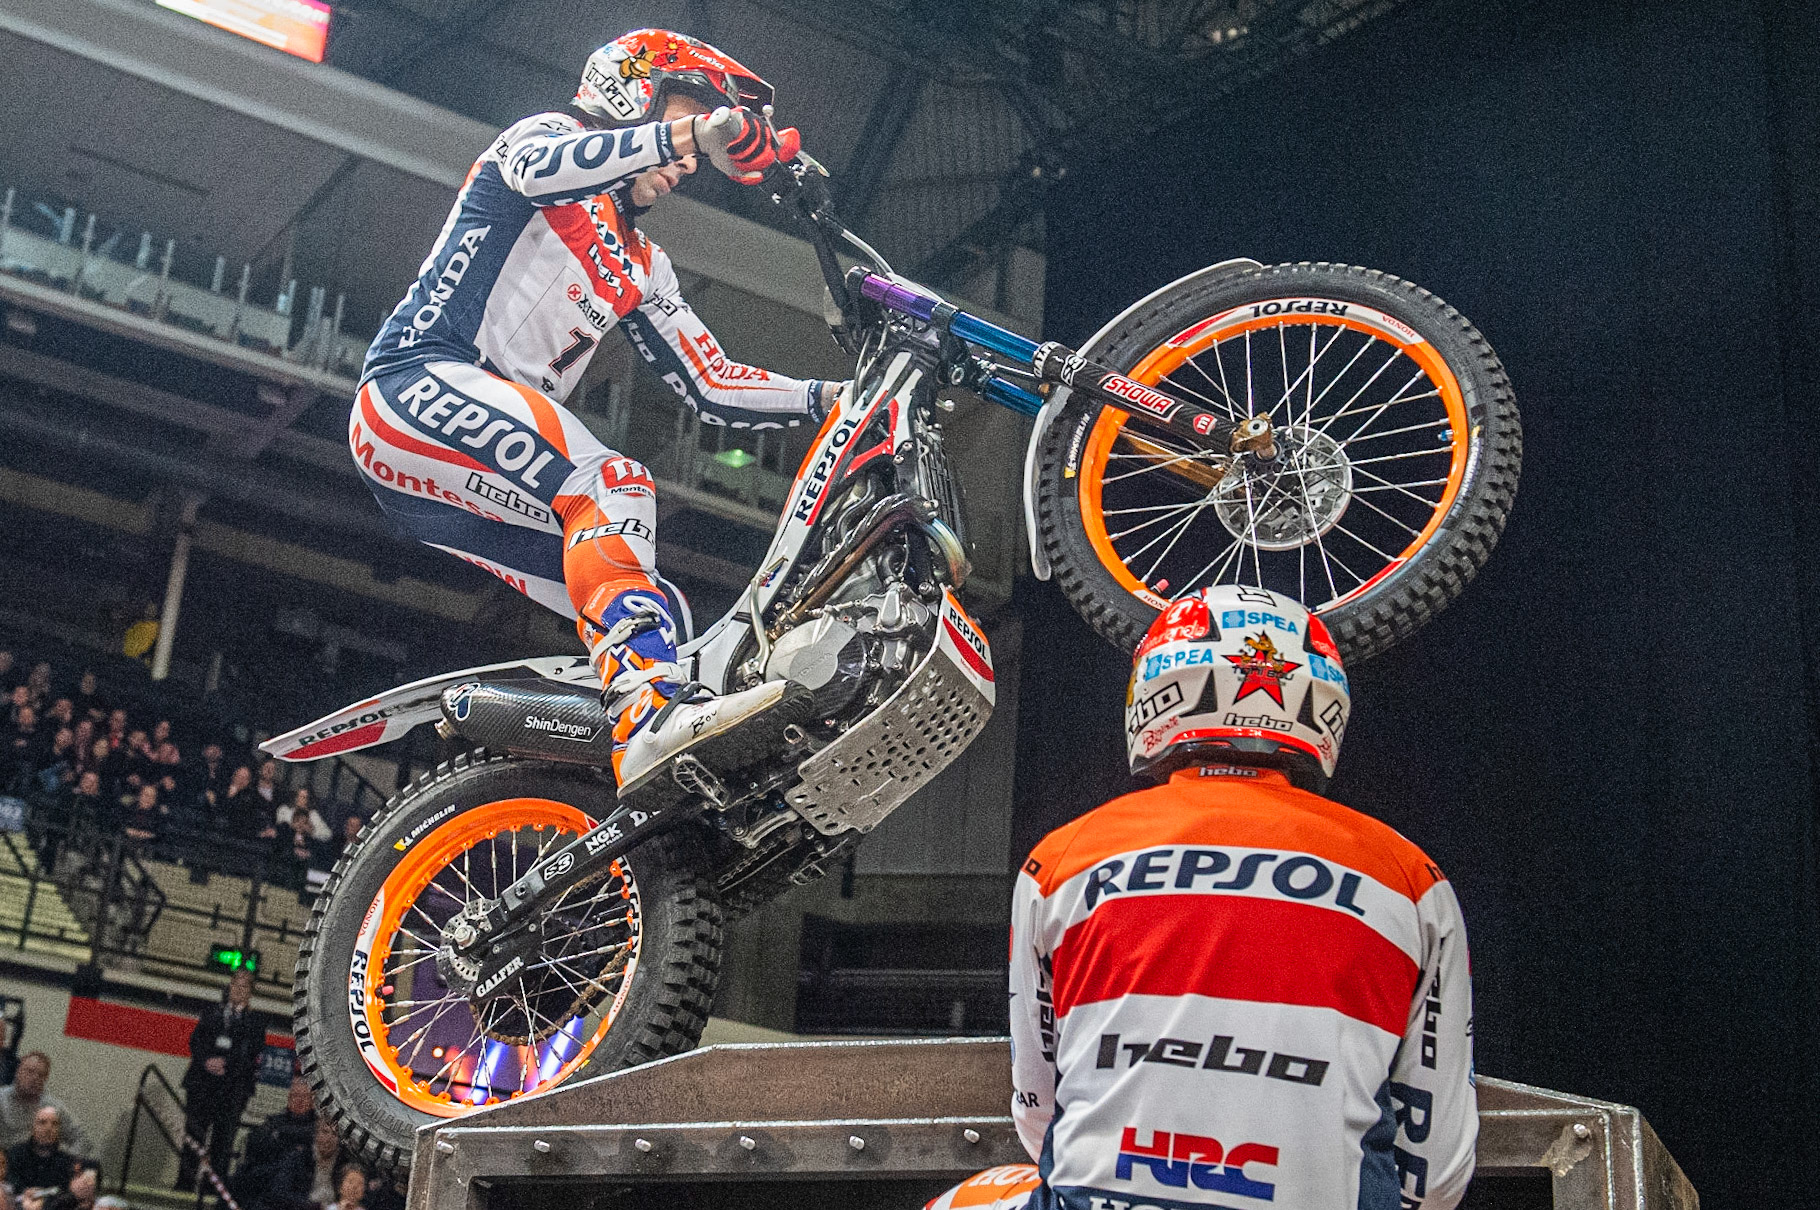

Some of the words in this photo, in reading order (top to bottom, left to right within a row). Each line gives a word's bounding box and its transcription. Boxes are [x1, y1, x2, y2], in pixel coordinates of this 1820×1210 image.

[398, 225, 491, 348] HONDA
[1250, 300, 1348, 318] REPSOL
[1382, 315, 1415, 338] HONDA
[548, 326, 599, 379] 1
[1102, 377, 1176, 415] SHOWA
[397, 375, 554, 489] REPSOL
[794, 416, 861, 522] REPSOL
[465, 472, 549, 523] hebo
[949, 607, 987, 660] REPSOL
[1247, 611, 1299, 635] SPEA
[1161, 648, 1214, 670] SPEA
[299, 708, 393, 746] REPSOL
[524, 715, 592, 737] ShinDengen
[1223, 712, 1294, 732] hebo
[1199, 766, 1258, 778] hebo
[410, 803, 456, 839] MICHELIN
[585, 822, 621, 852] NGK
[1084, 849, 1366, 917] REPSOL
[360, 898, 380, 937] HONDA
[475, 955, 525, 999] GALFER
[350, 949, 375, 1053] REPSOL
[1095, 1033, 1329, 1087] hebo
[1115, 1126, 1280, 1202] HRC
